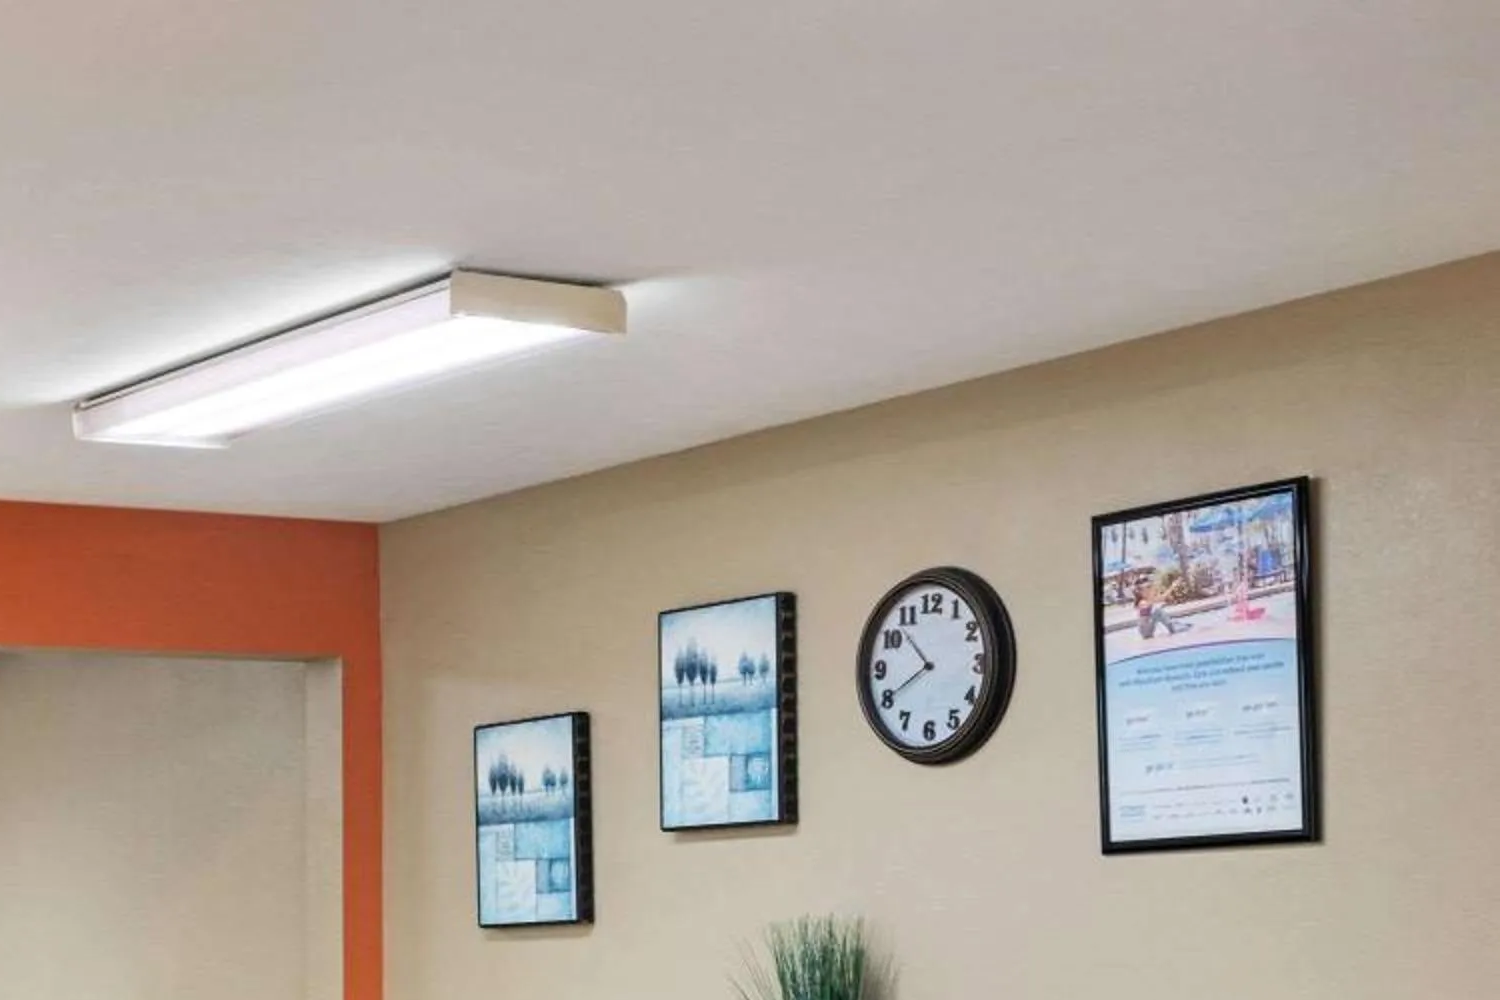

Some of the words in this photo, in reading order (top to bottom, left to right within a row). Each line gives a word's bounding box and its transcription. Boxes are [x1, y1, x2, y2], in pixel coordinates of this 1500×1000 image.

[920, 593, 943, 614] 12
[951, 599, 960, 619] 1
[899, 605, 917, 625] 11
[884, 630, 902, 649] 10
[965, 621, 978, 641] 2
[874, 660, 887, 680] 9
[972, 654, 984, 674] 3
[881, 690, 894, 709] 8
[964, 686, 976, 705] 4
[899, 711, 911, 731] 7
[947, 709, 960, 730] 5
[923, 721, 936, 740] 6
